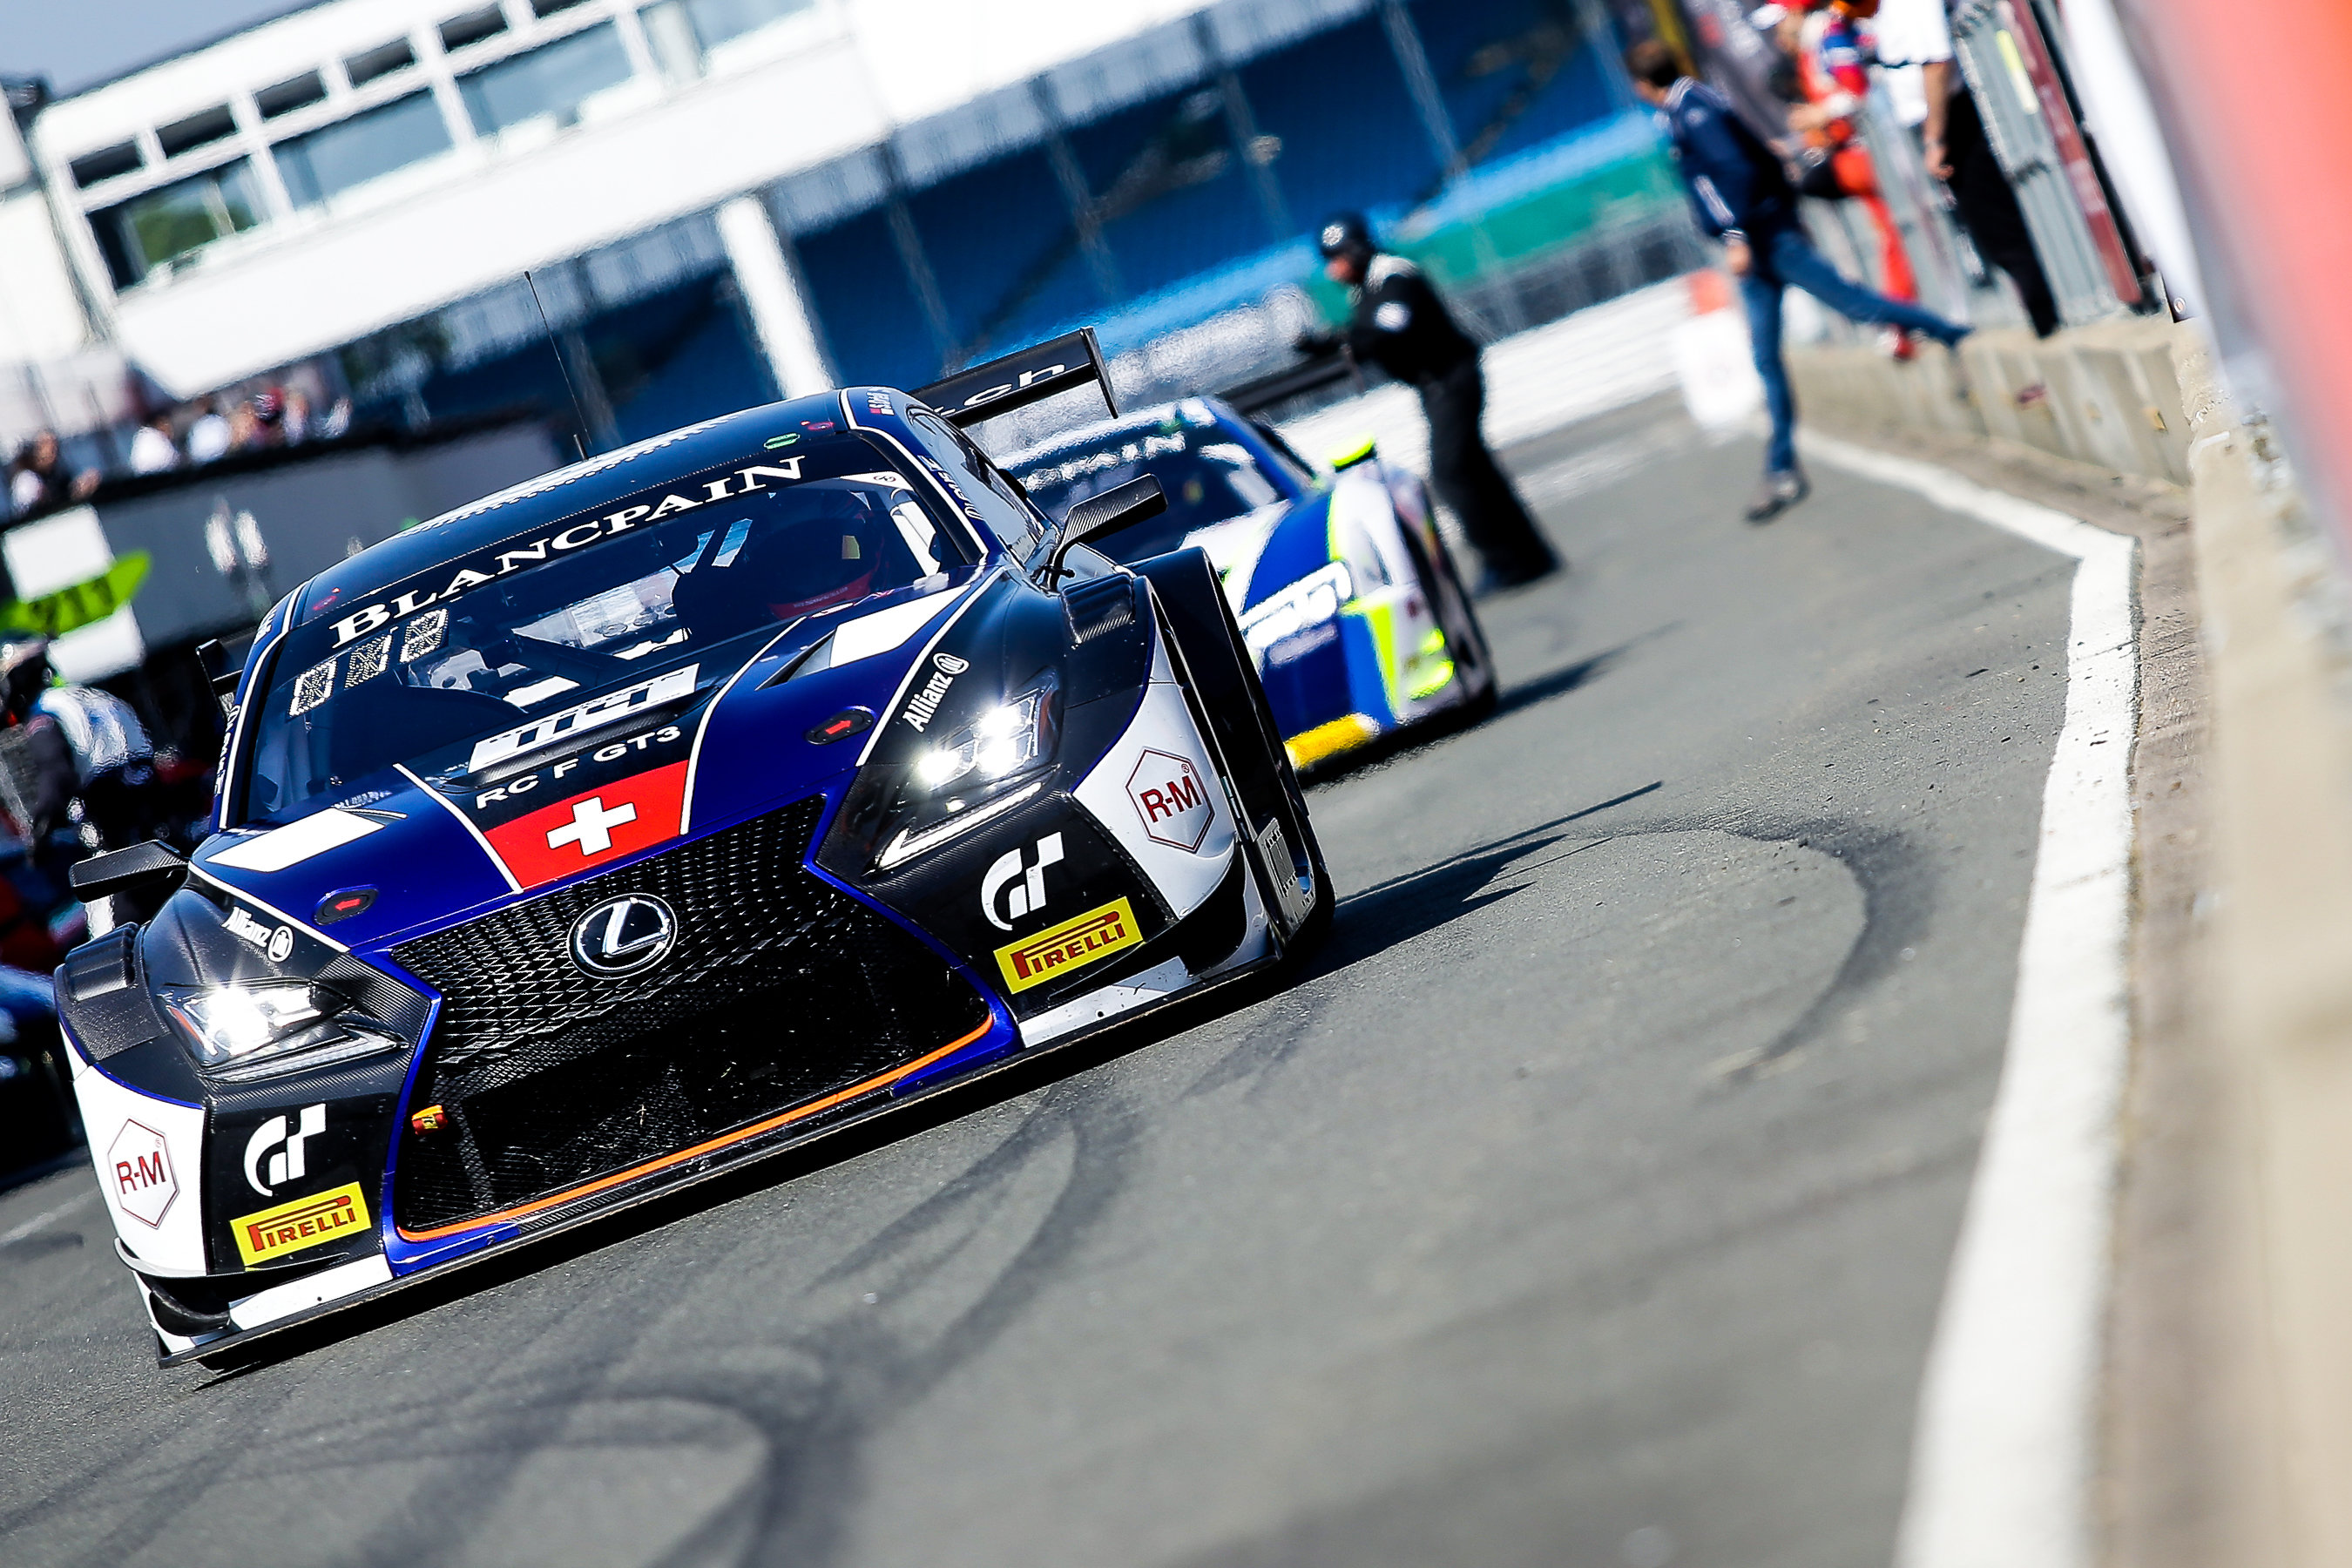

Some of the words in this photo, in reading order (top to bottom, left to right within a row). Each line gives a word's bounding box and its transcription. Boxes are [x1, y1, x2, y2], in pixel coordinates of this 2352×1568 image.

[934, 363, 1065, 416] ch
[329, 455, 806, 649] BLANCPAIN
[902, 671, 954, 733] Allianz
[476, 775, 539, 809] RC
[554, 758, 579, 780] F
[593, 726, 681, 762] GT3
[1139, 774, 1202, 823] R-M
[220, 906, 273, 948] Allianz
[1010, 910, 1126, 980] PIRELLI
[116, 1151, 167, 1195] R-M
[246, 1194, 357, 1253] PIRELLI
